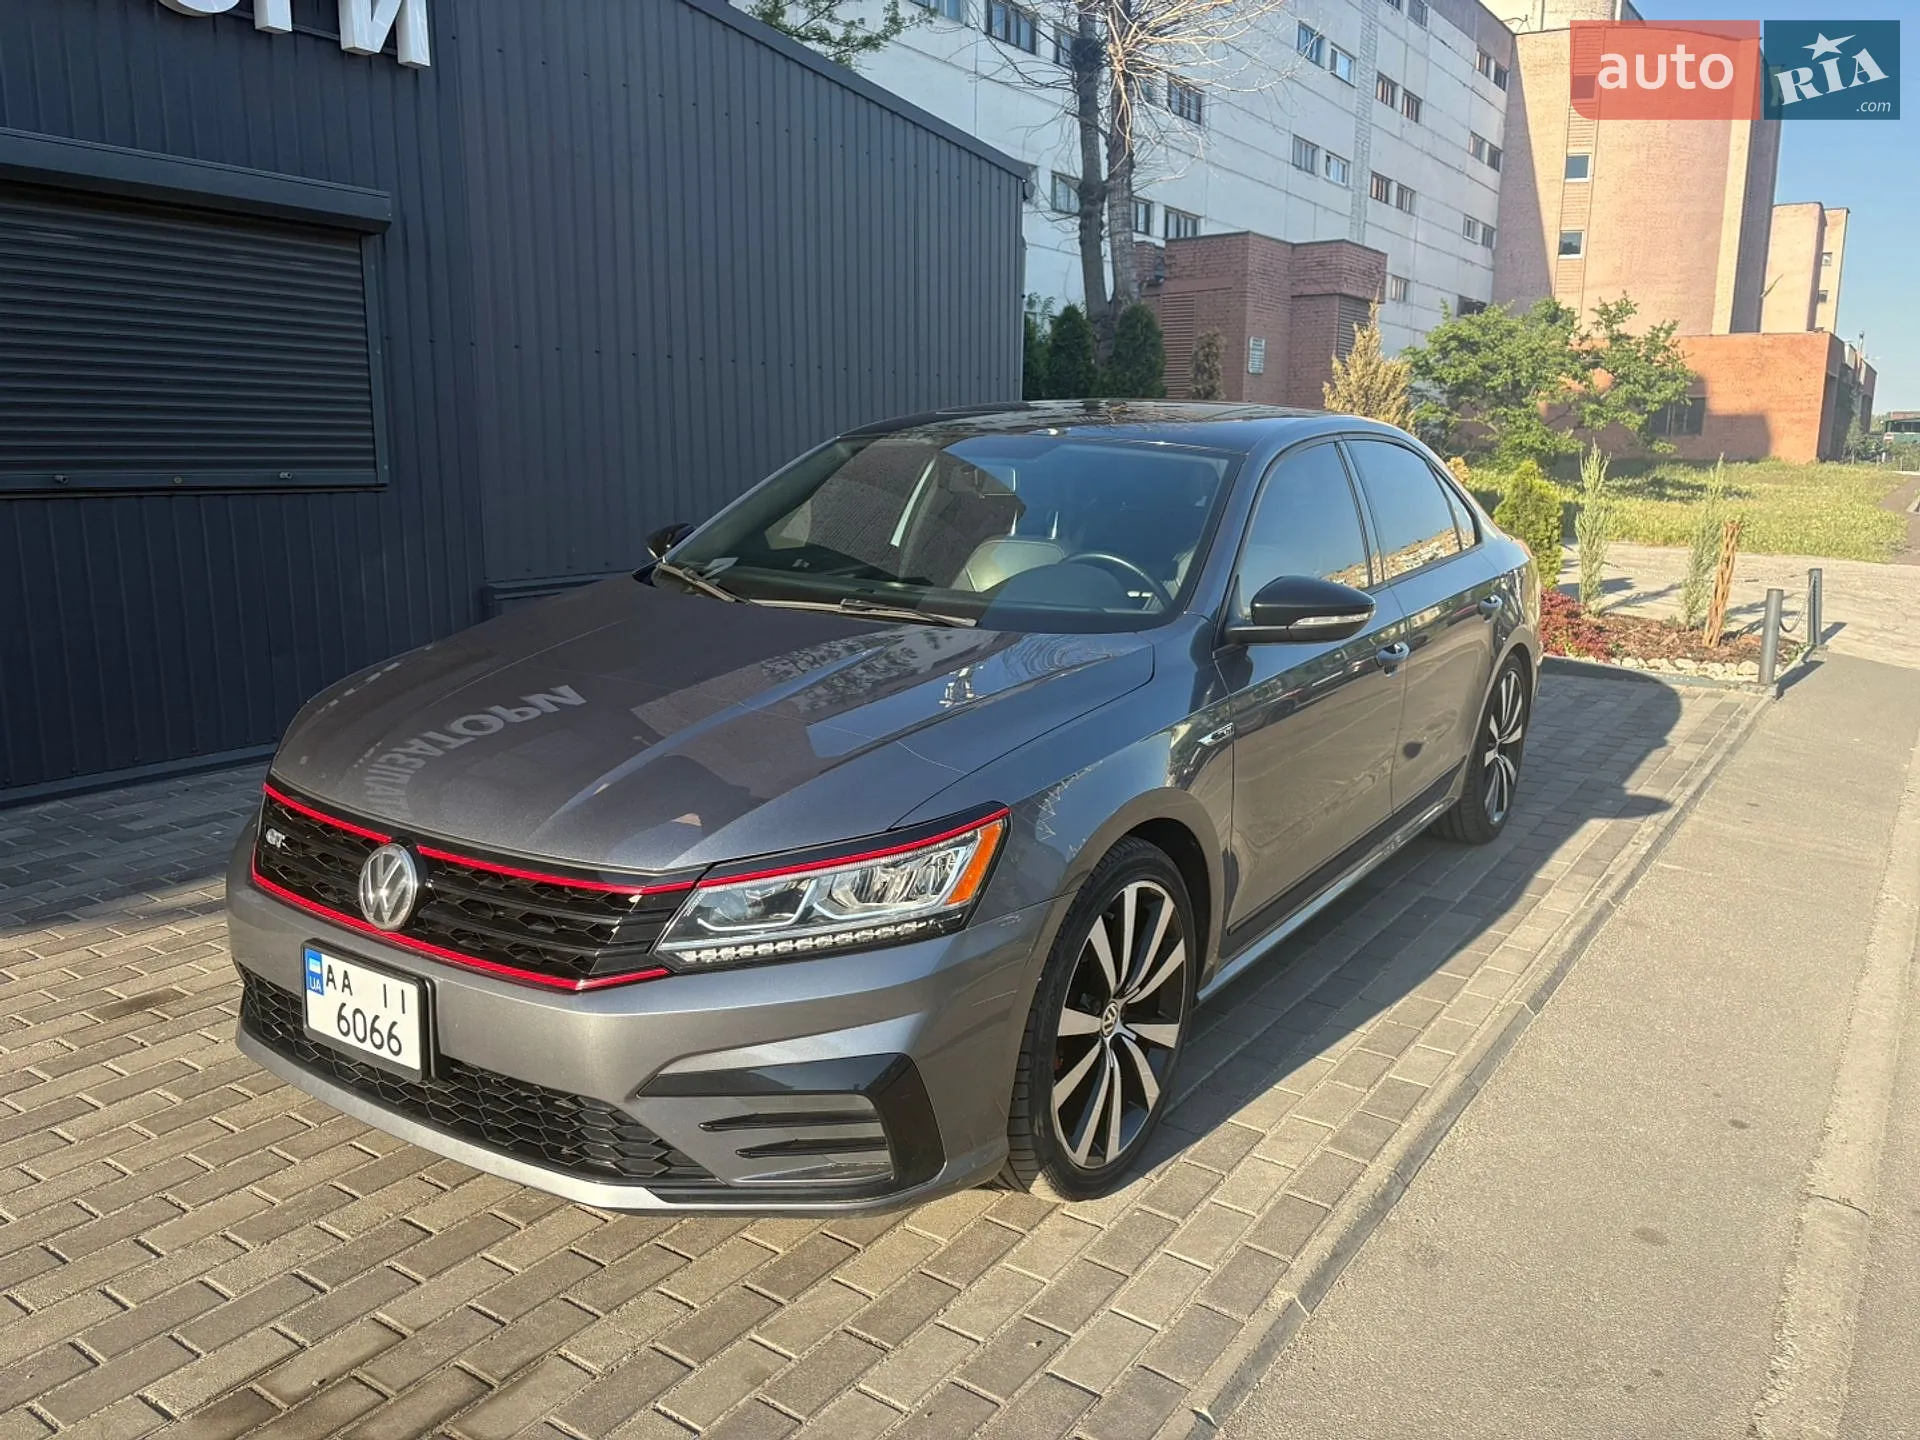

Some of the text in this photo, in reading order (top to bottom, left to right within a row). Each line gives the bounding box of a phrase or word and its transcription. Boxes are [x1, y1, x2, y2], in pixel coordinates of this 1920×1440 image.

[308, 975, 323, 991] UA
[325, 964, 353, 997] AA
[336, 1002, 403, 1057] 6066
